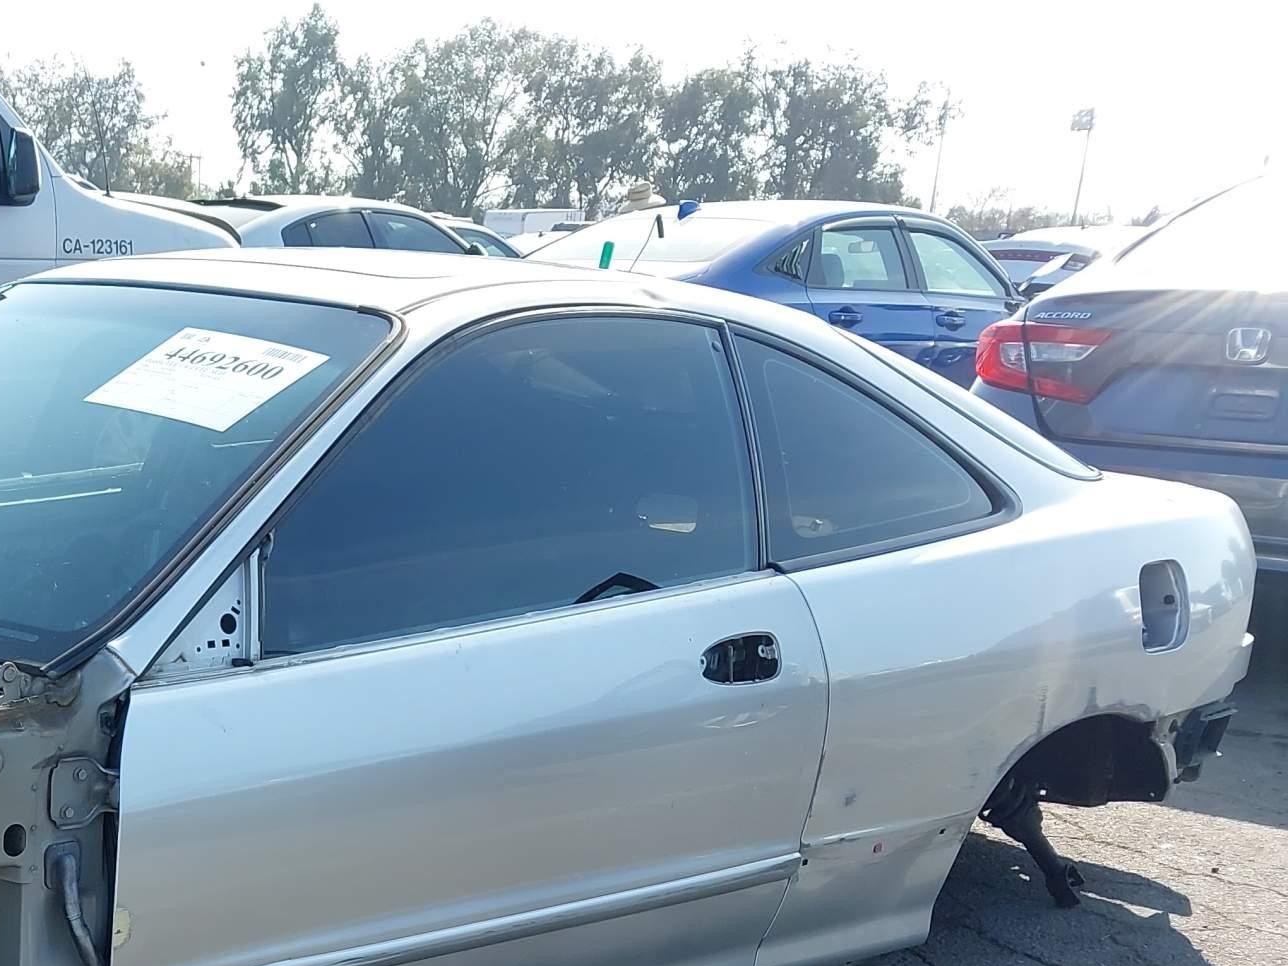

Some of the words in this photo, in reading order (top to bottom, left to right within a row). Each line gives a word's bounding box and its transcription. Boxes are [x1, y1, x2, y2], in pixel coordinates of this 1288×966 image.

[62, 238, 133, 256] CA-123161
[1033, 311, 1092, 319] ACCORD
[164, 346, 285, 380] 44692600
